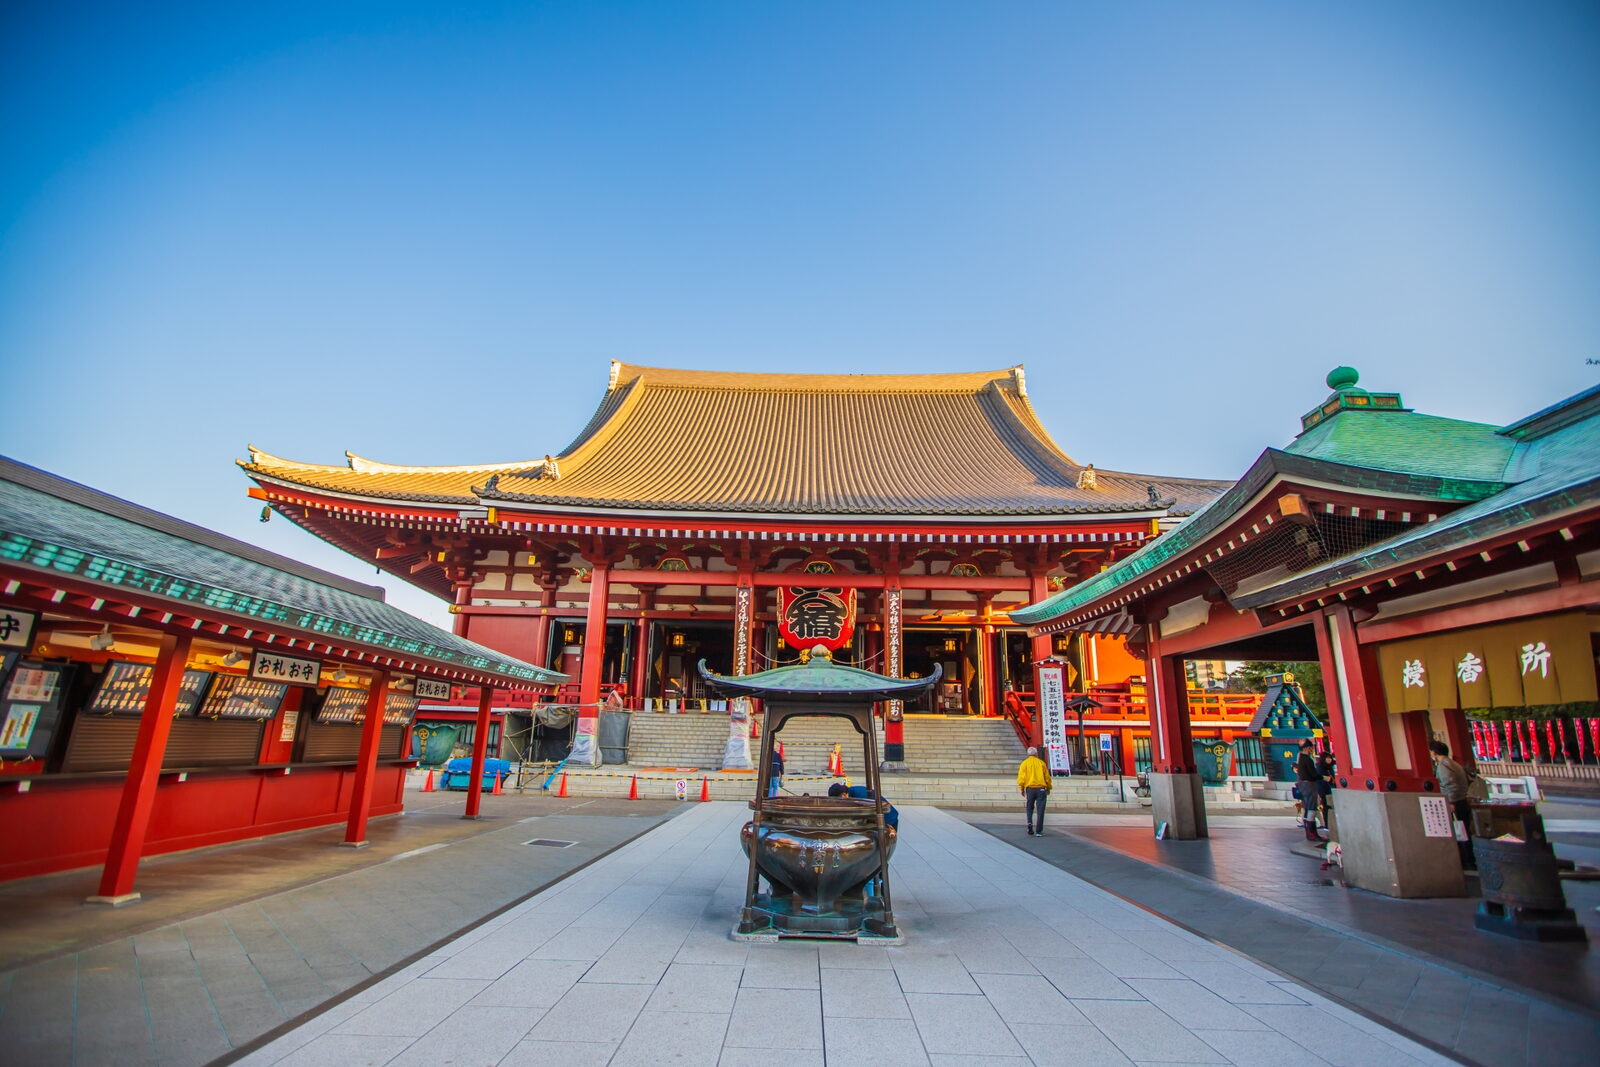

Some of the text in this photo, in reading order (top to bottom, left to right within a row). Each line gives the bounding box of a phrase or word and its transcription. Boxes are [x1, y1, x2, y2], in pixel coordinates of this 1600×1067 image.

[258, 657, 313, 680] お札お守
[418, 682, 448, 697] お札お守
